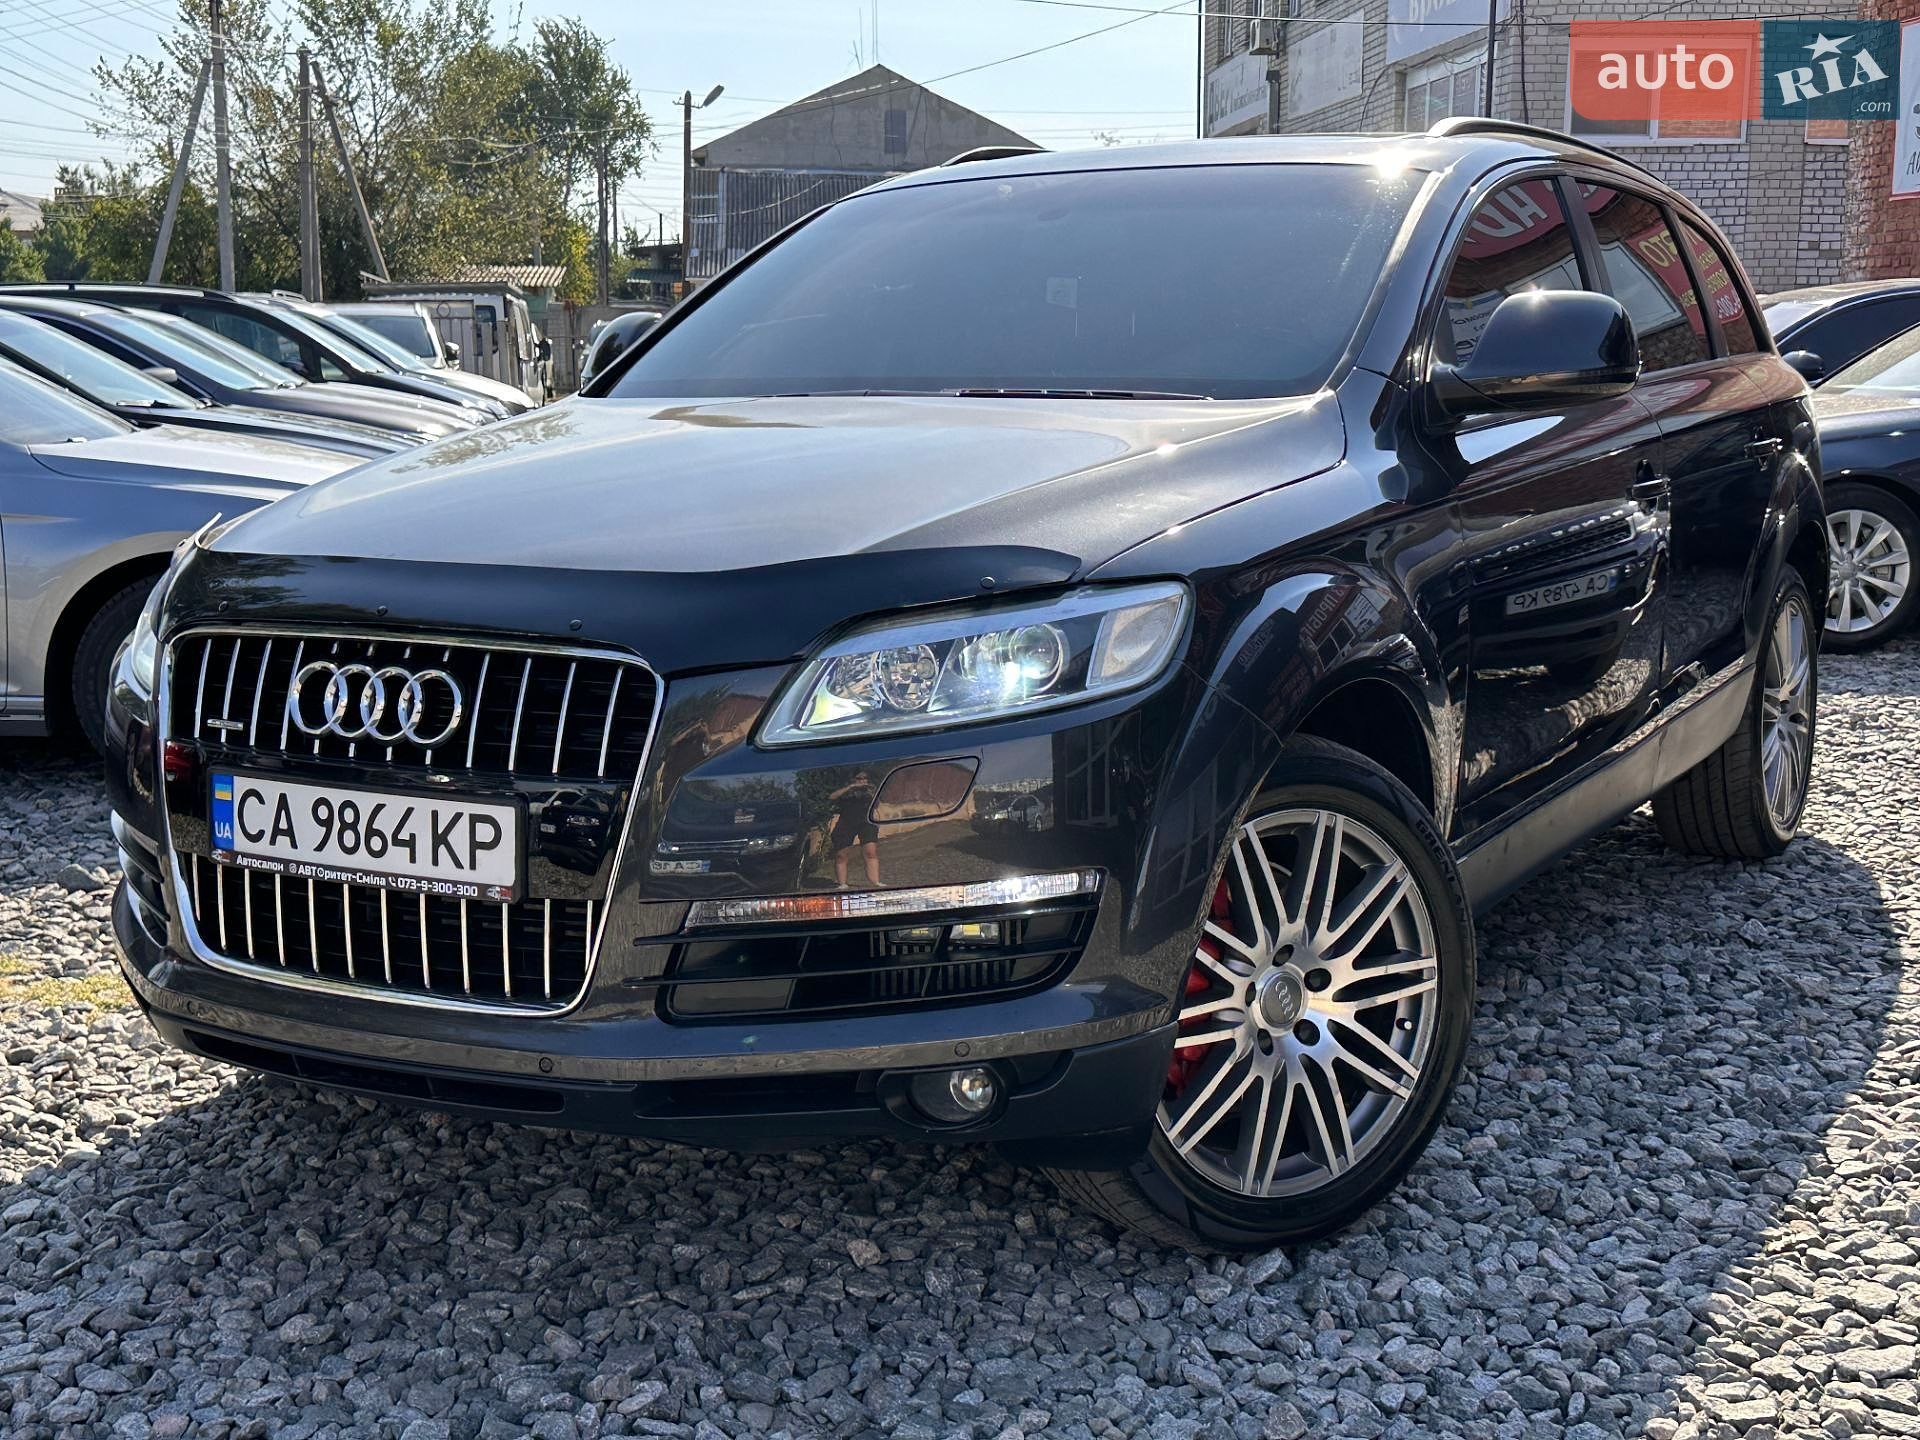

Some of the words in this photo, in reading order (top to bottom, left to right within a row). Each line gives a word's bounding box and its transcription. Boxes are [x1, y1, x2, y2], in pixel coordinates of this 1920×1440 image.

[214, 821, 232, 840] UA
[238, 788, 298, 850] CA
[311, 797, 417, 865] 9864
[431, 810, 503, 870] KP
[236, 854, 284, 872] Автосалон
[397, 876, 479, 897] 073-9-300-300
